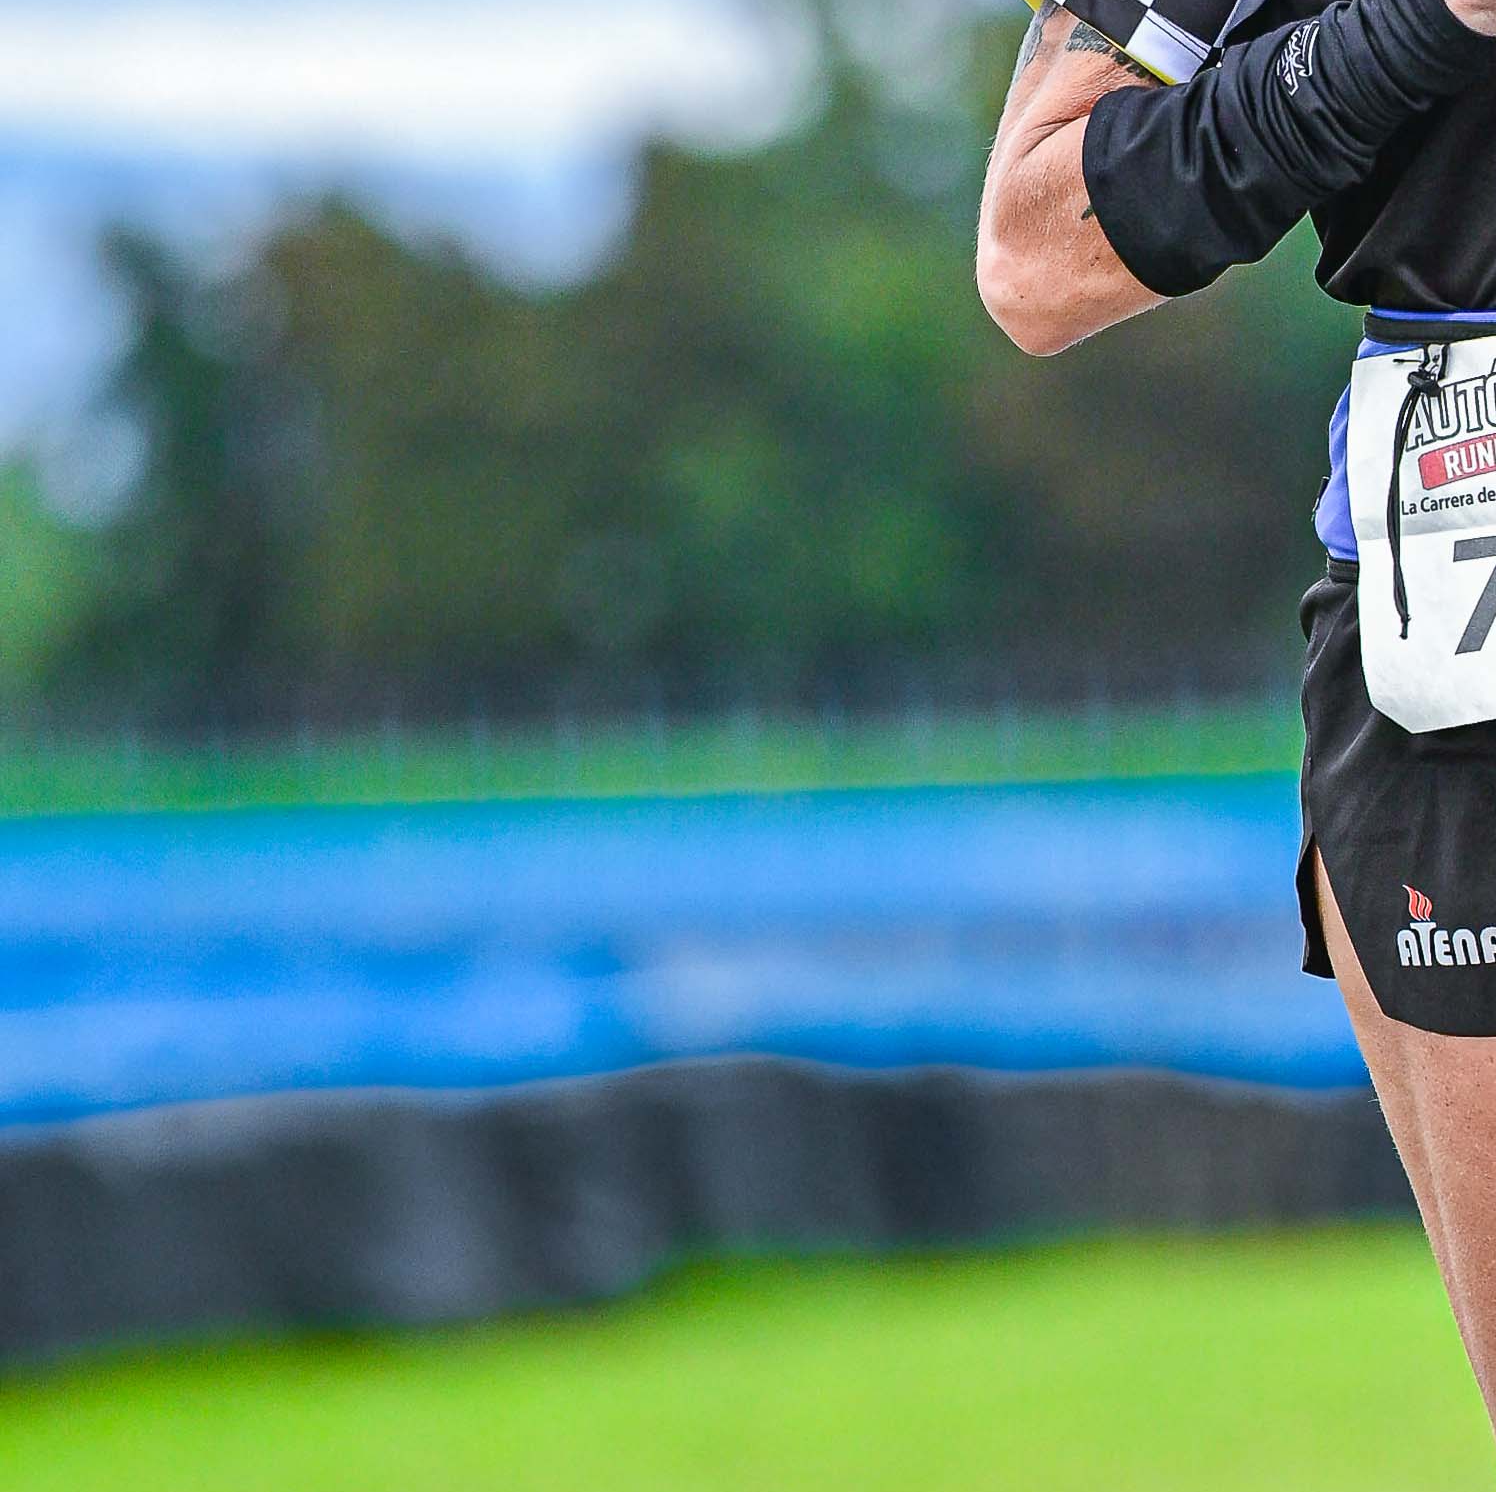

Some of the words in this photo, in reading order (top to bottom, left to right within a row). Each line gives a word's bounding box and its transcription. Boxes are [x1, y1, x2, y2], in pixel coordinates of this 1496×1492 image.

[1401, 500, 1418, 516] La
[1420, 492, 1474, 512] Carrera
[1477, 487, 1496, 503] de
